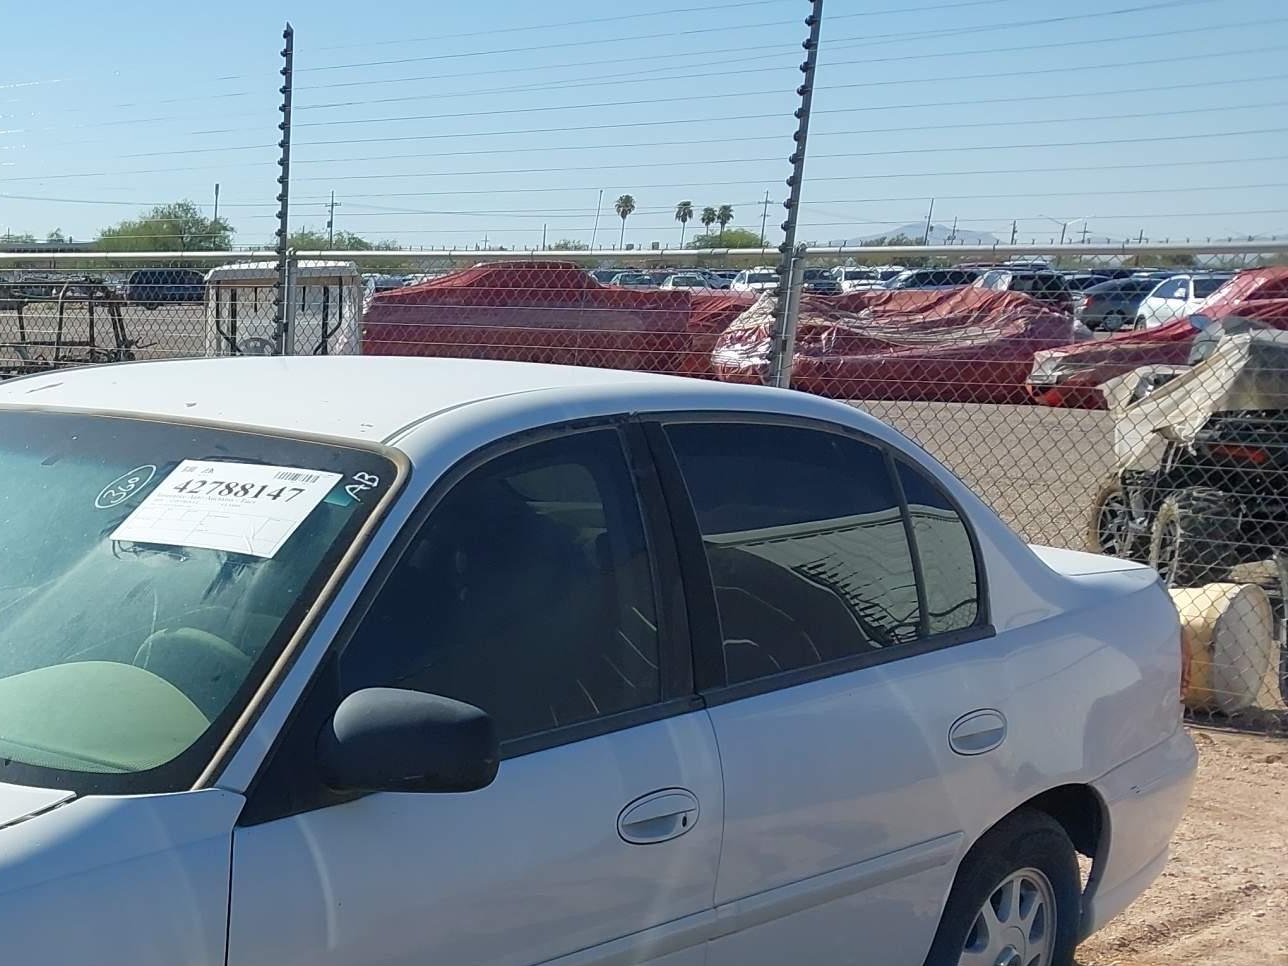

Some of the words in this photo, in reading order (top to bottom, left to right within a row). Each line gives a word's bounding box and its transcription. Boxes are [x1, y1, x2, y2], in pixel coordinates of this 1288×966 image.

[102, 476, 140, 504] 360
[172, 478, 306, 503] 42788147
[344, 471, 380, 503] AB
